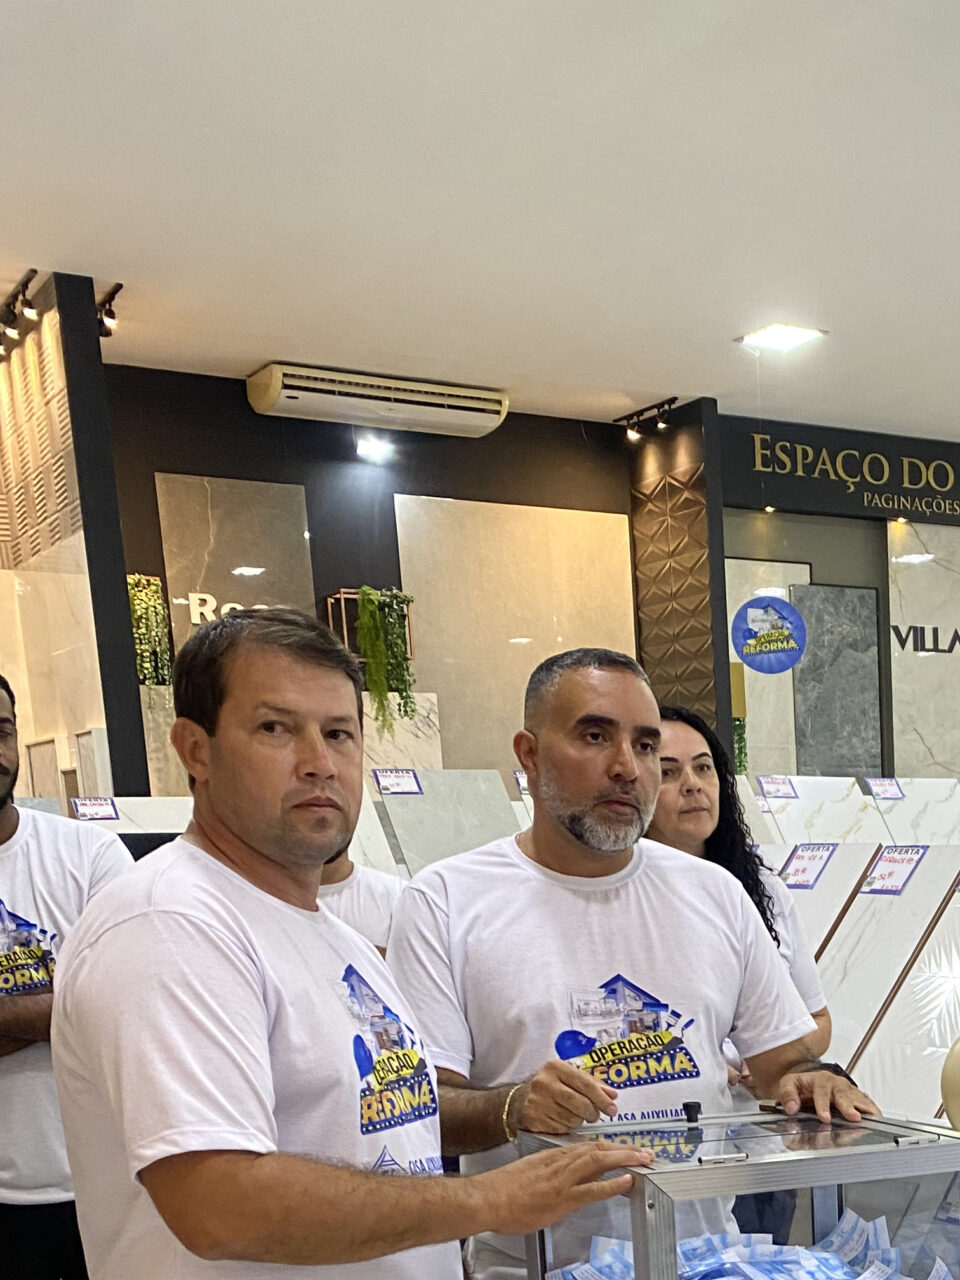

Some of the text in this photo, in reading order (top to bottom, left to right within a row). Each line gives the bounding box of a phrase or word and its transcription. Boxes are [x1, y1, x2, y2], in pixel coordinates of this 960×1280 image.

[751, 432, 890, 493] ESPAÇO
[900, 456, 955, 492] DO
[863, 491, 960, 516] PAGINAÇÕES
[742, 639, 799, 655] REFORMA
[886, 848, 921, 856] OFERTA
[592, 1052, 694, 1083] FORMA
